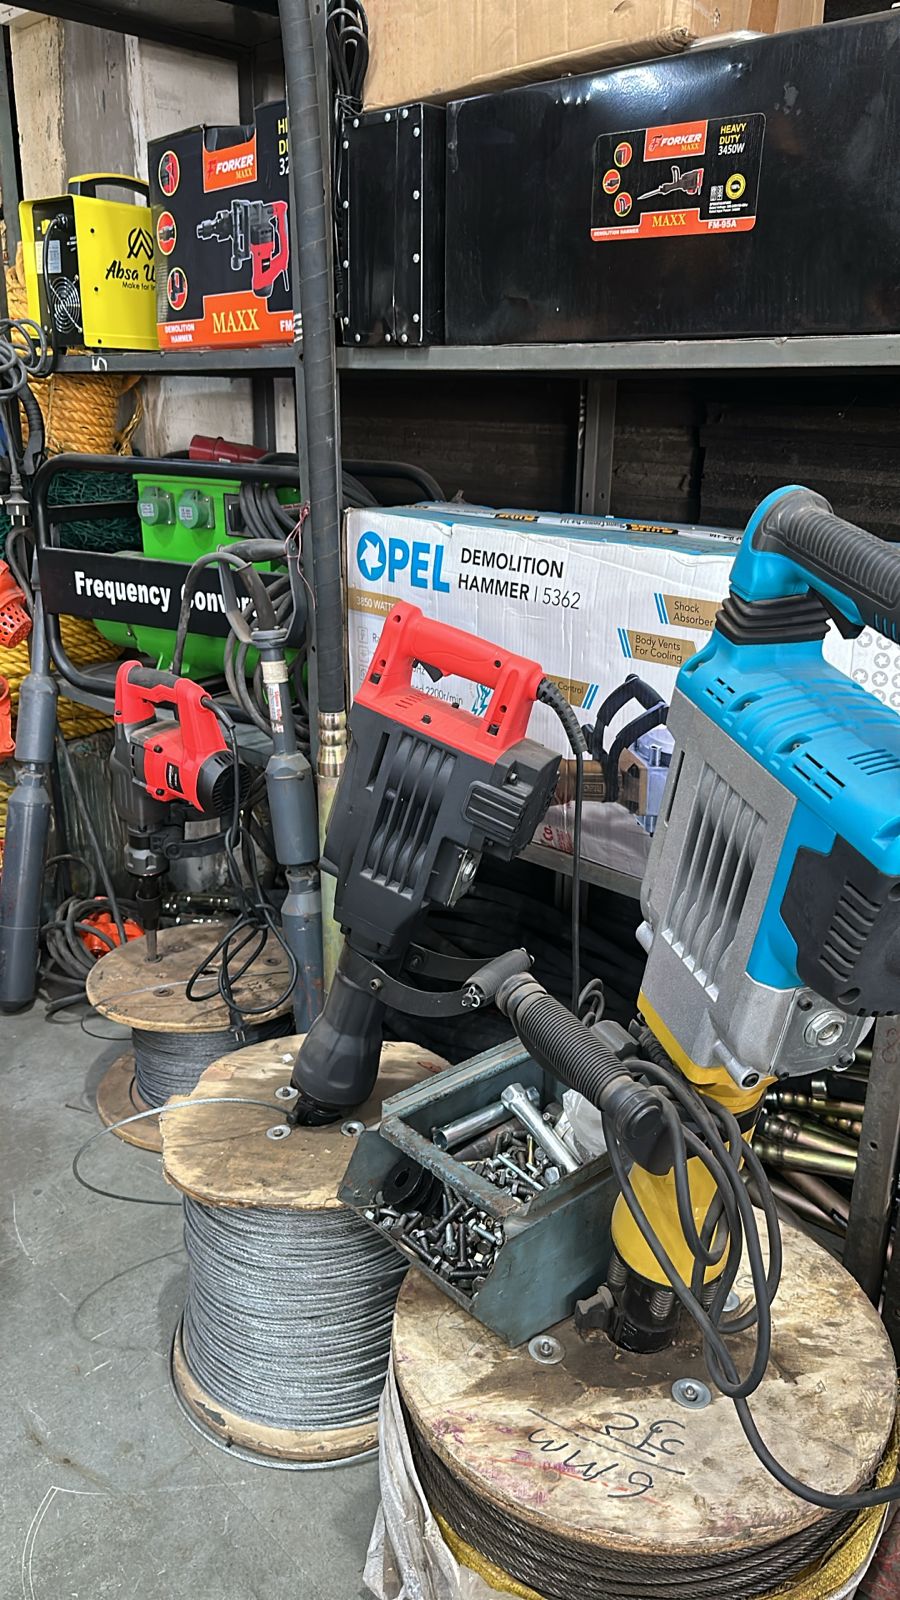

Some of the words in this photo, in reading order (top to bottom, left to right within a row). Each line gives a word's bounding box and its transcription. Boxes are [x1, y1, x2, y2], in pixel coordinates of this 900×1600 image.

[720, 123, 746, 135] HEAVY
[660, 133, 703, 147] FORKER
[719, 134, 741, 145] DUTY
[680, 143, 700, 152] MAXX
[718, 143, 745, 156] 3450W
[215, 153, 254, 175] FORKER
[235, 167, 253, 179] MAXX
[652, 213, 687, 228] MAXX
[707, 219, 737, 229] FM-95A
[105, 260, 139, 281] Absa
[212, 308, 260, 334] MAXX
[164, 323, 195, 334] DEMOLITION
[170, 334, 193, 343] HAMMER
[356, 531, 451, 593] OPEL
[460, 547, 565, 579] DEMOLITION
[74, 571, 171, 613] Frequency
[458, 573, 530, 601] HAMMER
[542, 587, 582, 610] 5362
[356, 595, 374, 609] 3850
[674, 600, 700, 613] Shock
[673, 612, 714, 627] Absorber
[635, 634, 657, 649] Body
[657, 638, 681, 651] Vents
[634, 645, 649, 656] For
[650, 647, 683, 664] Cooling
